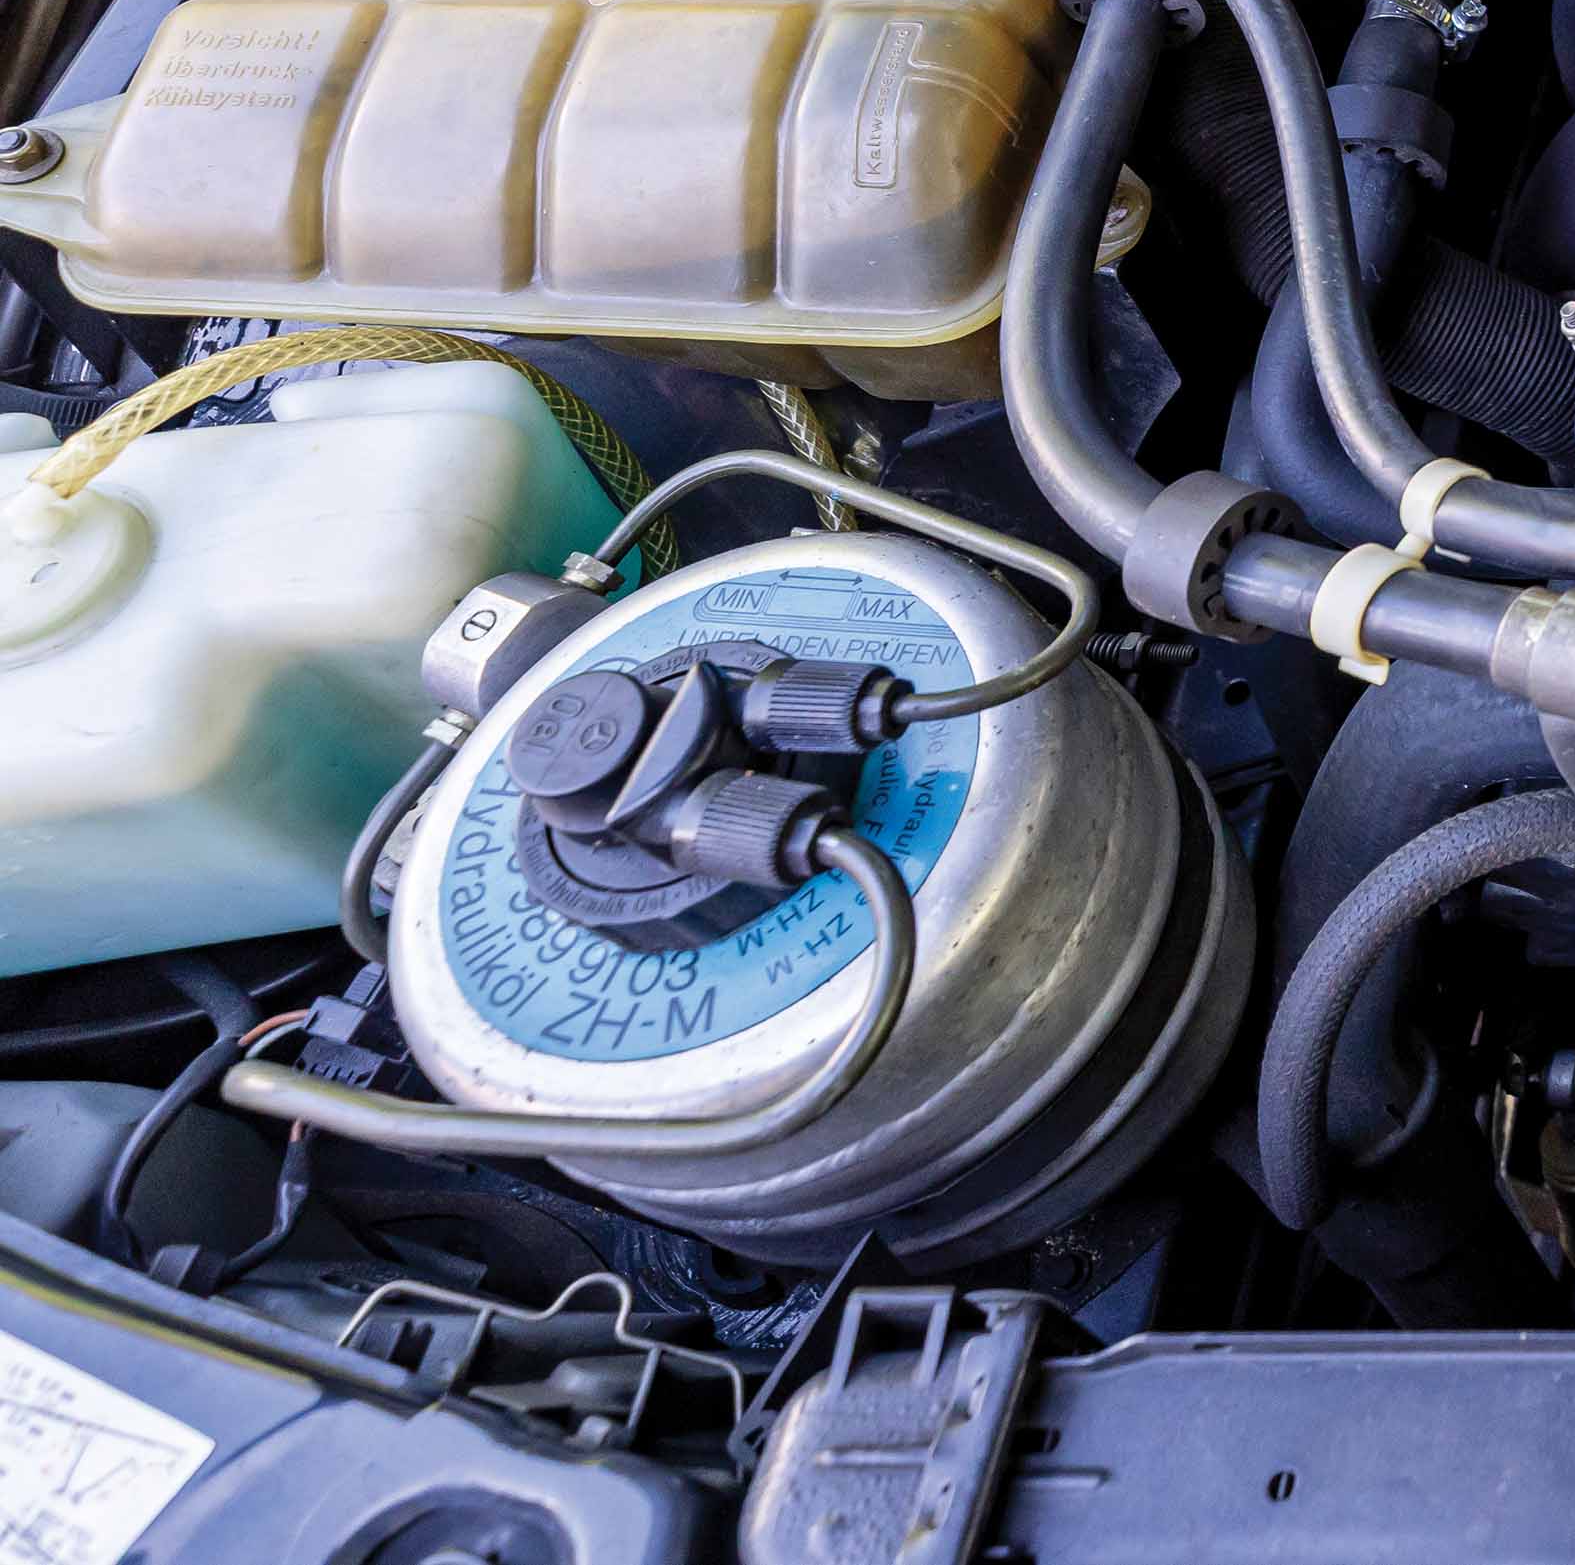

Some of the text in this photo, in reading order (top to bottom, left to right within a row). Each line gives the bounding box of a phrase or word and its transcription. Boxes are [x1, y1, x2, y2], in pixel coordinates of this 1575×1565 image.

[184, 29, 320, 52] Vorsicht!
[144, 85, 297, 110] Kühlsystem
[713, 587, 764, 610] MIN
[856, 597, 917, 621] MAX
[737, 887, 825, 956] ZH-M
[541, 987, 716, 1050] ZH-M
